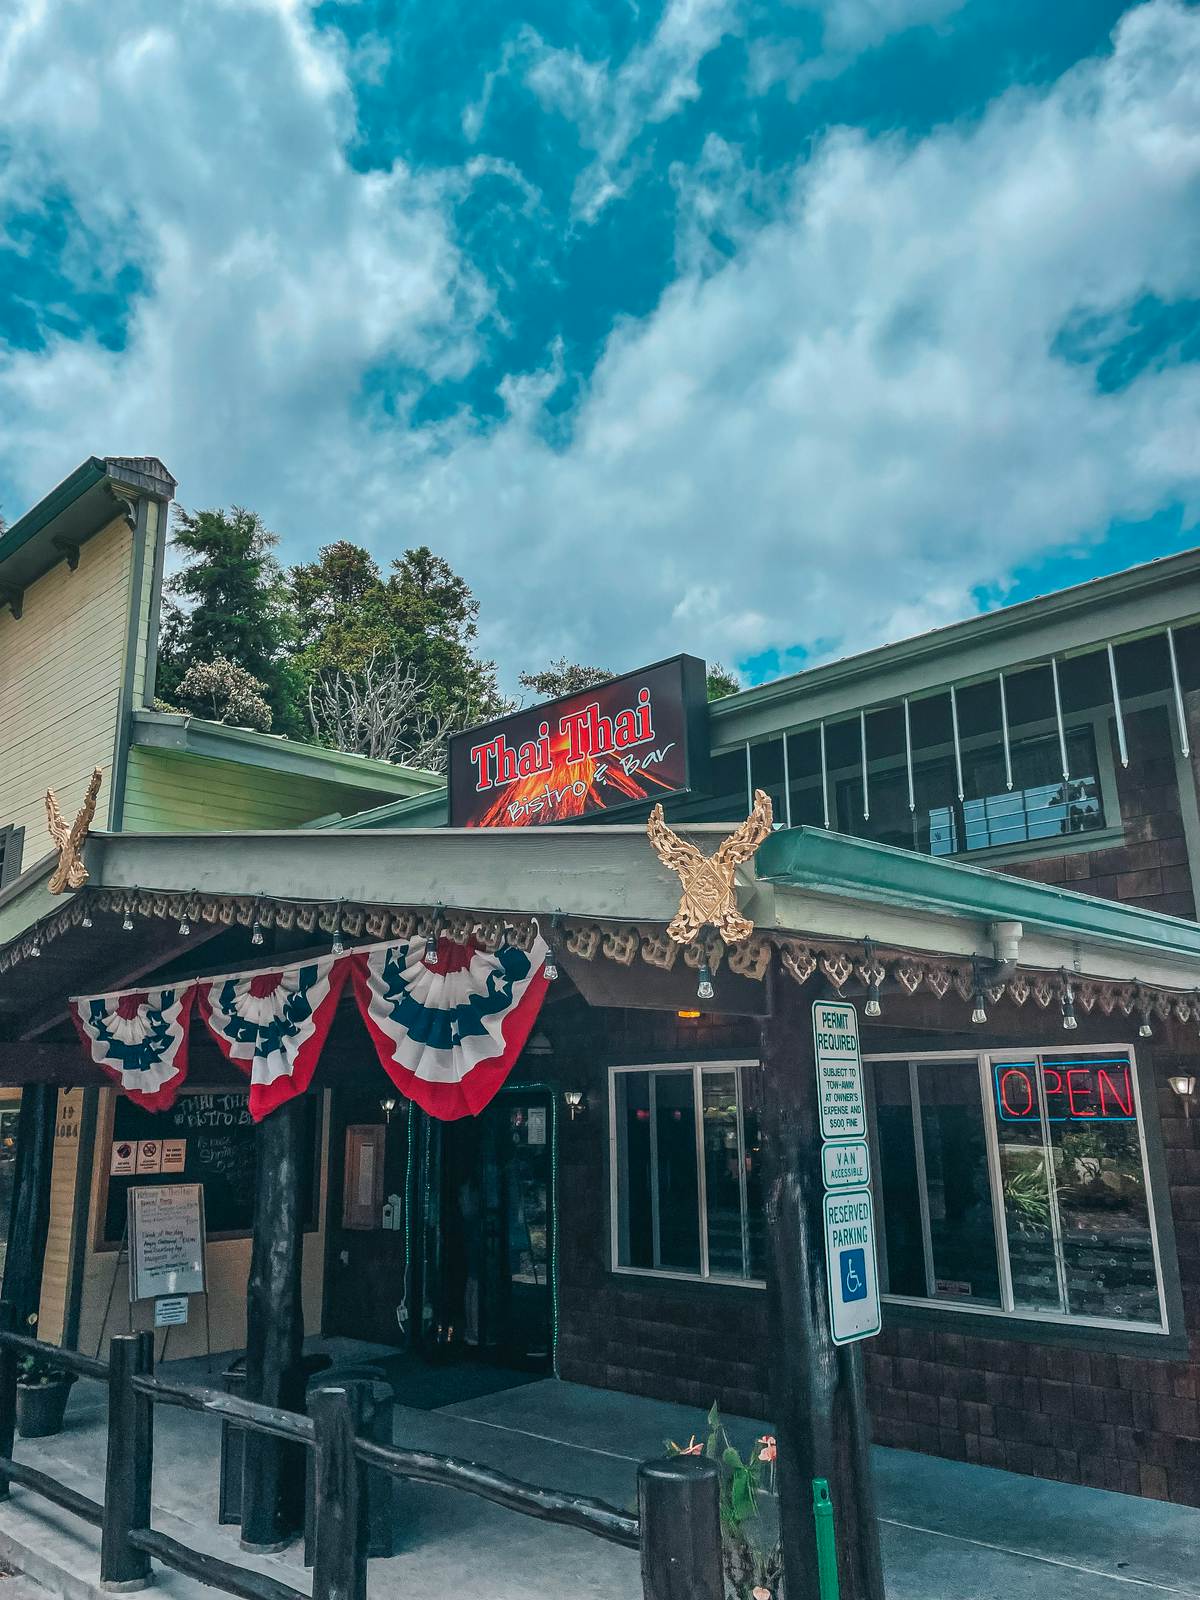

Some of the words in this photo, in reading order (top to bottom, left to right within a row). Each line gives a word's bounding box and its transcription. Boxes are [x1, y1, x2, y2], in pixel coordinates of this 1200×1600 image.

[471, 721, 552, 792] Thai
[559, 687, 656, 765] Thai
[507, 780, 586, 822] Bistro
[593, 762, 609, 786] &
[619, 742, 676, 776] Bar
[822, 1012, 849, 1030] PERMIT
[818, 1033, 857, 1052] REQUIRED
[823, 1067, 848, 1077] SUBJECT
[849, 1068, 857, 1077] TO
[826, 1080, 855, 1089] TOW-AWAY
[1001, 1067, 1134, 1116] OPEN
[825, 1092, 832, 1102] AT
[833, 1092, 859, 1102] OWNER'S
[823, 1105, 849, 1115] EXPENSE
[850, 1105, 862, 1114] AND
[829, 1118, 845, 1129] $500
[846, 1118, 858, 1127] FINE
[836, 1151, 856, 1166] VAN
[830, 1167, 863, 1179] ACCESSIBLE
[828, 1202, 869, 1225] RESERVED
[832, 1225, 868, 1248] PARKING
